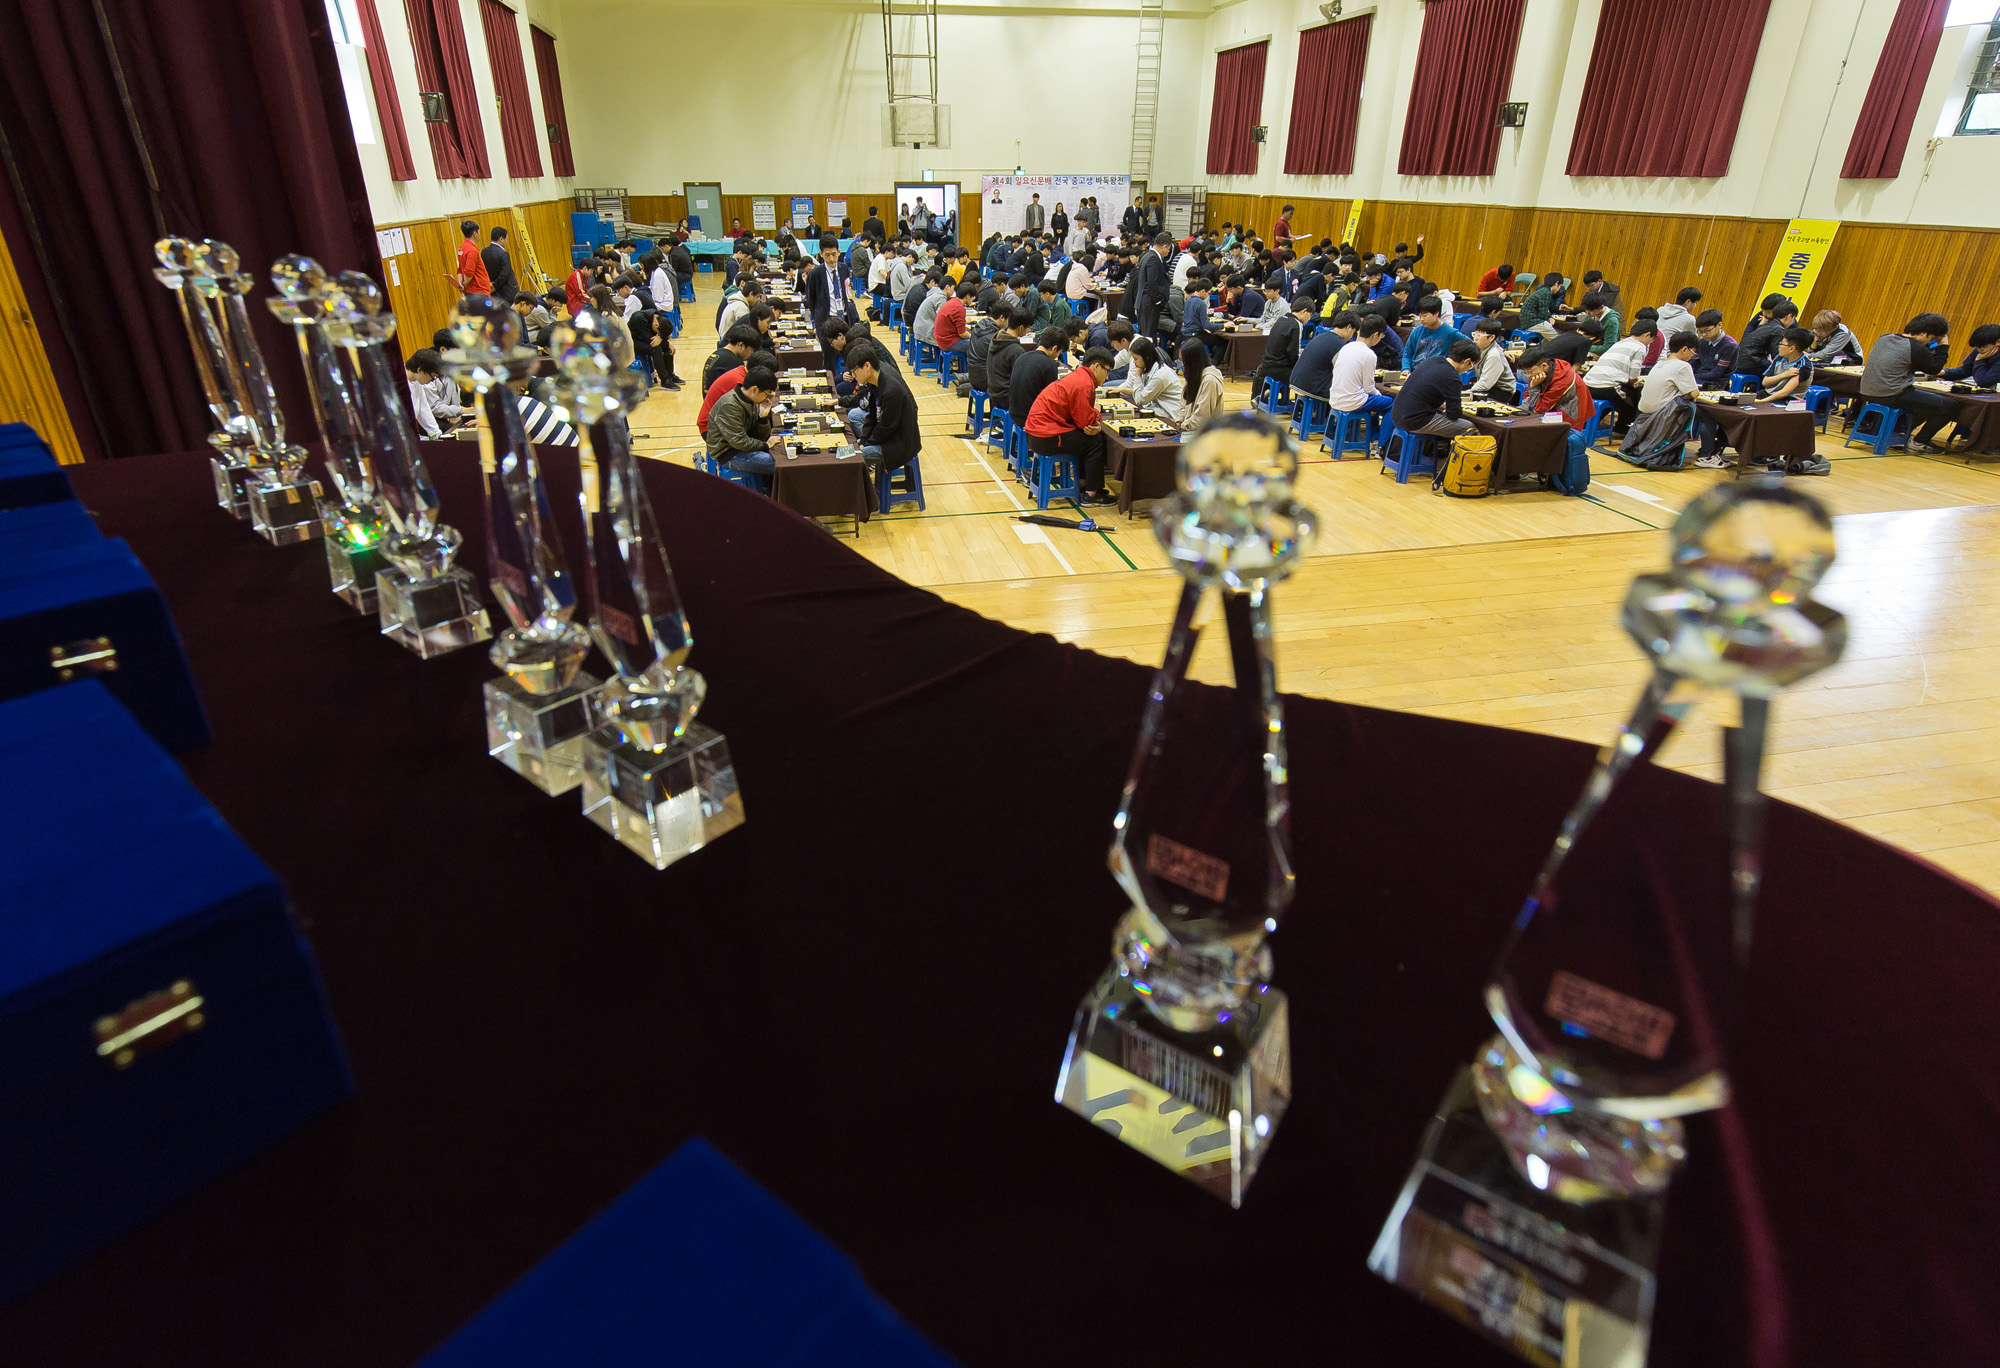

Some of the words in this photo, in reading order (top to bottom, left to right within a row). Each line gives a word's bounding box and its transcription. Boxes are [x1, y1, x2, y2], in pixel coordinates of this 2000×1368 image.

[991, 176, 1013, 185] 제4회
[1015, 176, 1052, 185] 일요신문배
[1054, 176, 1069, 185] 전국
[1071, 176, 1093, 185] 중고생
[1095, 176, 1124, 185] 바둑왕전
[1781, 252, 1811, 302] 중등
